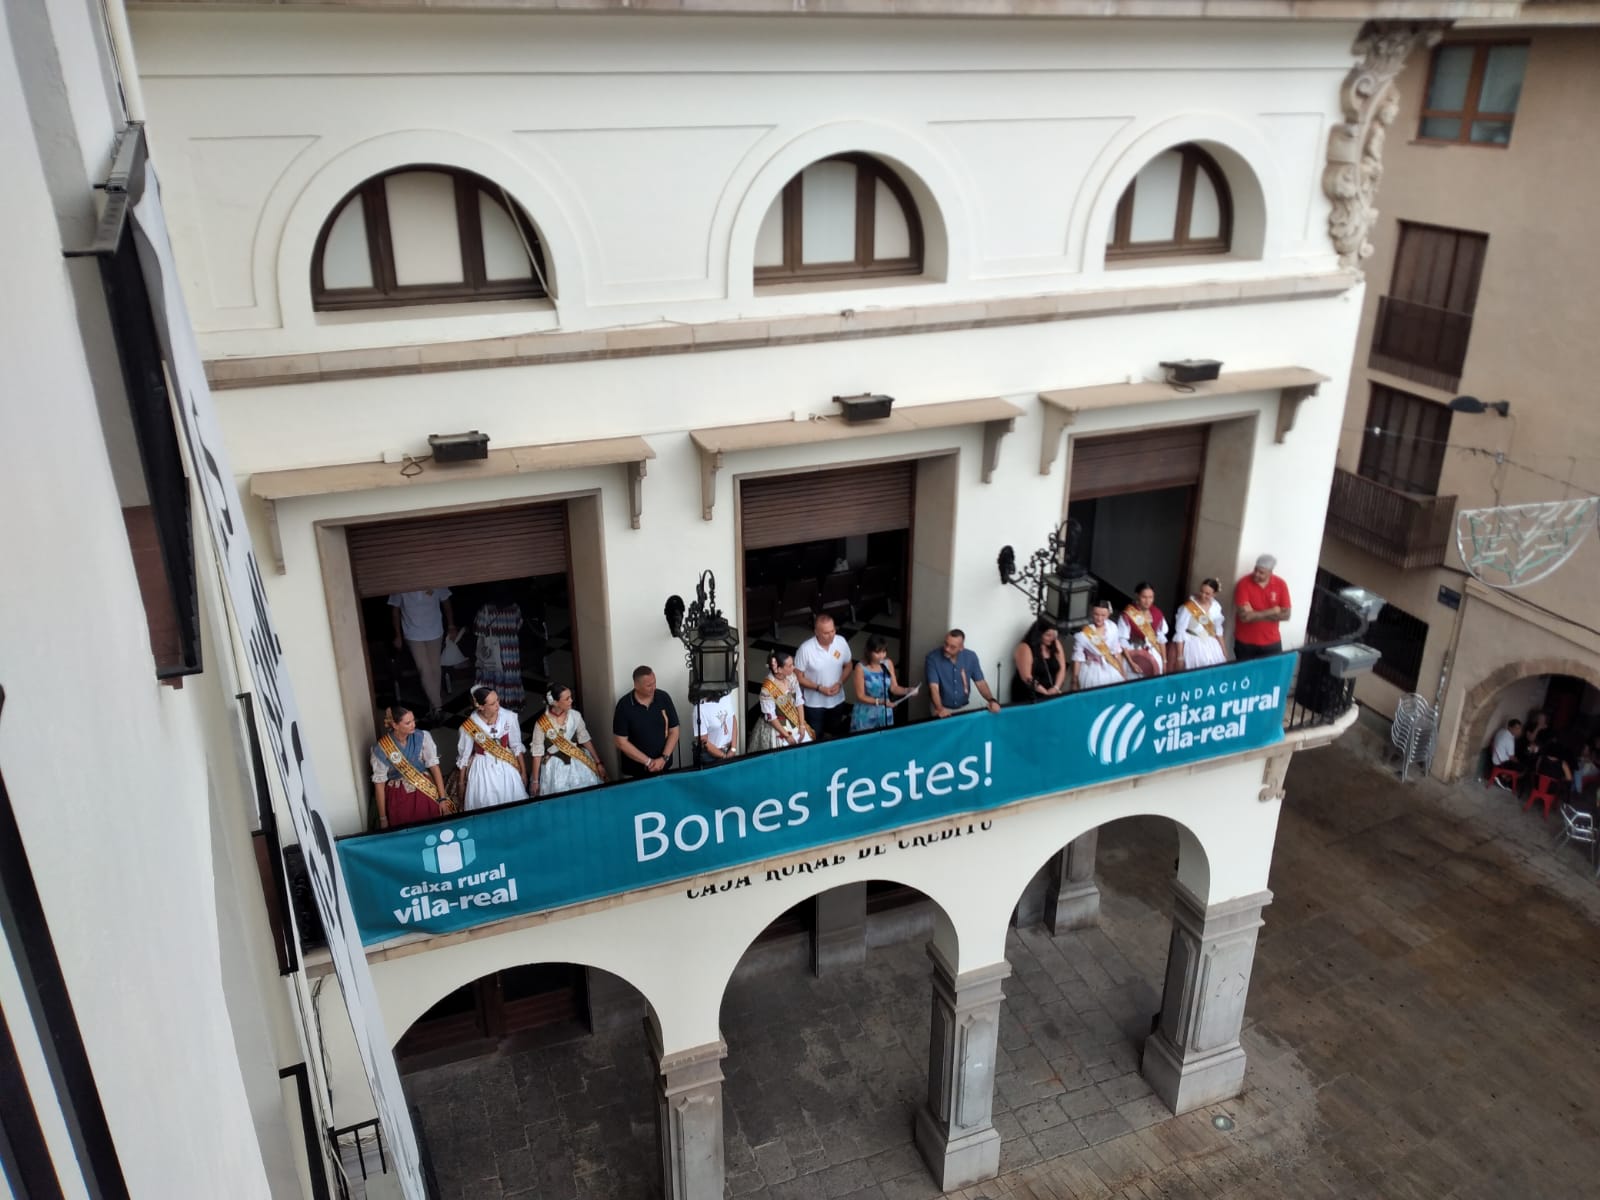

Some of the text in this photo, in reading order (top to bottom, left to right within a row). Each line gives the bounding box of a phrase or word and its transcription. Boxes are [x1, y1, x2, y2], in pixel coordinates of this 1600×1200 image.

[1153, 686, 1281, 732] caixa rural
[1155, 677, 1251, 707] FUNDACIÓ
[1153, 713, 1247, 754] vila-real
[634, 740, 993, 863] Bones festes!
[393, 878, 518, 925] vila-real
[400, 862, 506, 898] caixa rural
